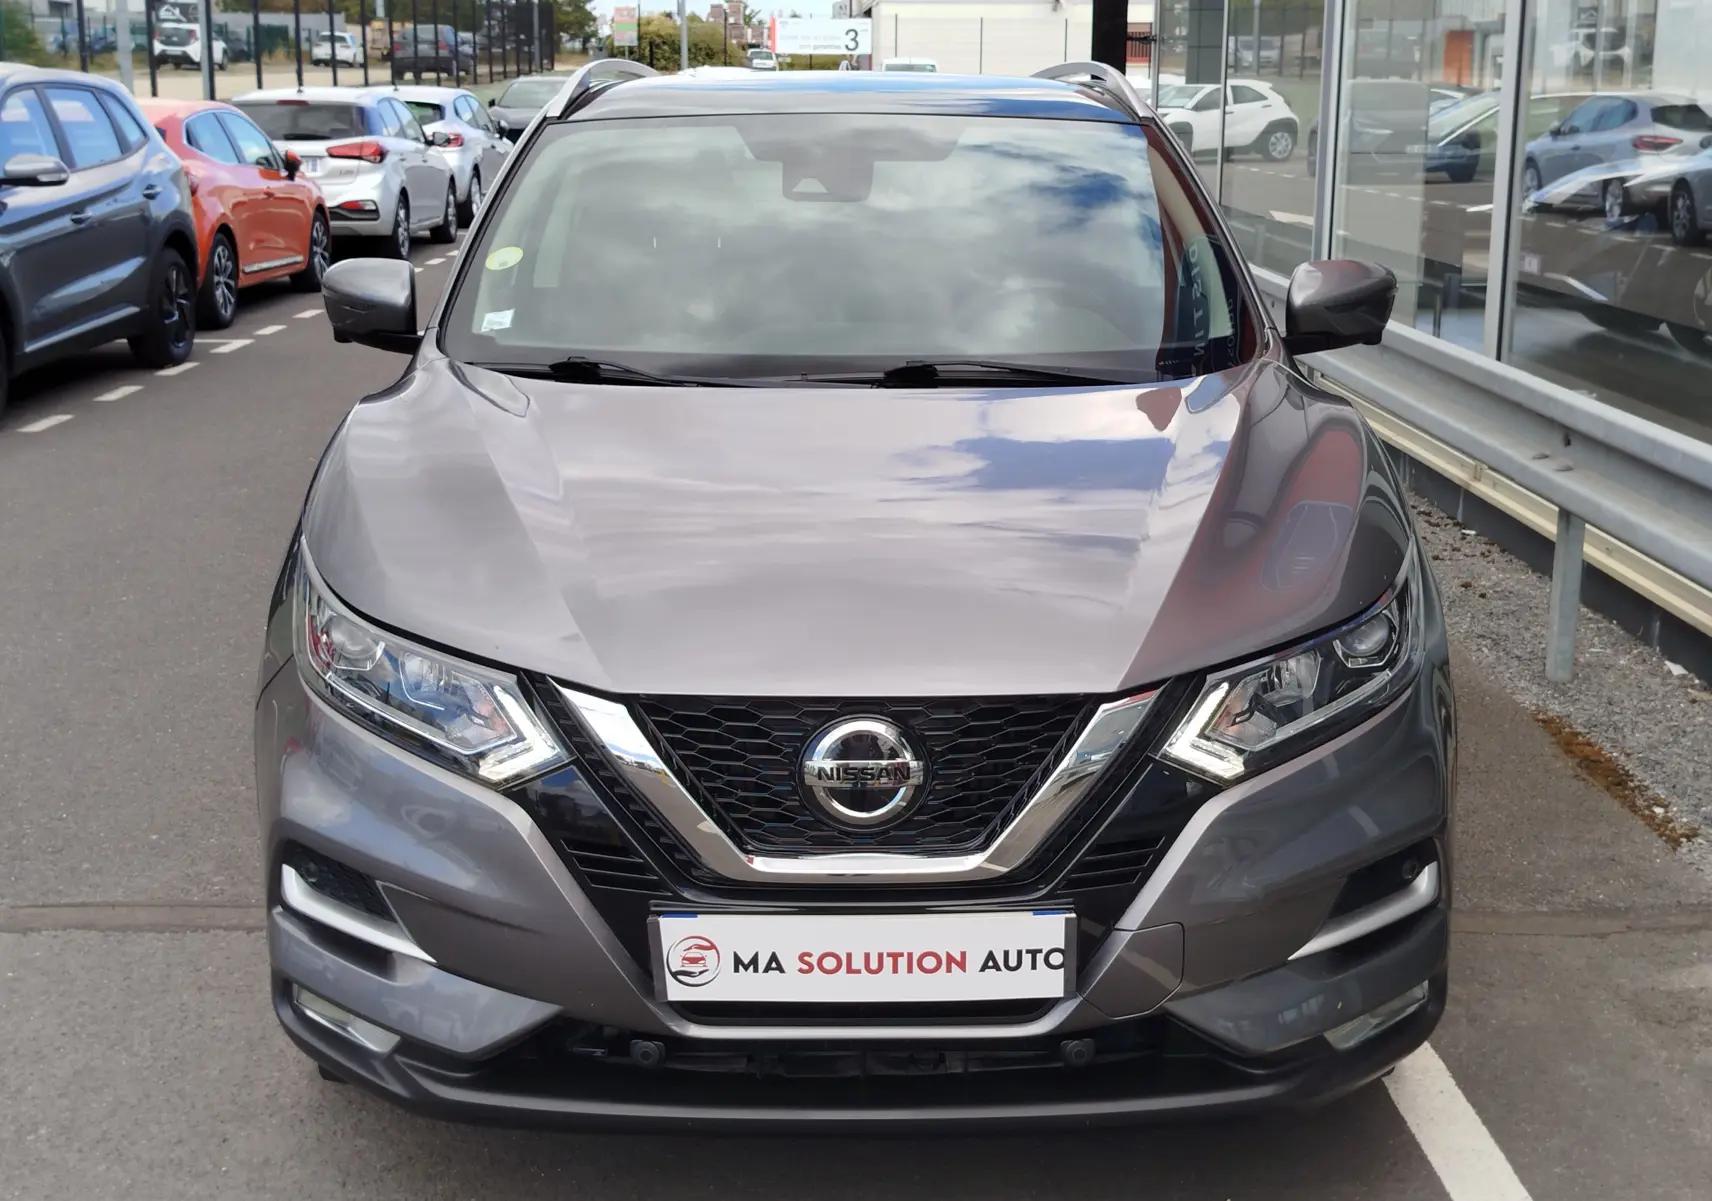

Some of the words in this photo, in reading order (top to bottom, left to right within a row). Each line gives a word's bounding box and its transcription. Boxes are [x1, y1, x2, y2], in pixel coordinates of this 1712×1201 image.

[845, 28, 858, 51] 3
[817, 766, 911, 781] NISSAN
[733, 951, 786, 974] MA
[797, 950, 967, 975] SOLUTION
[978, 947, 1065, 973] AUTO
